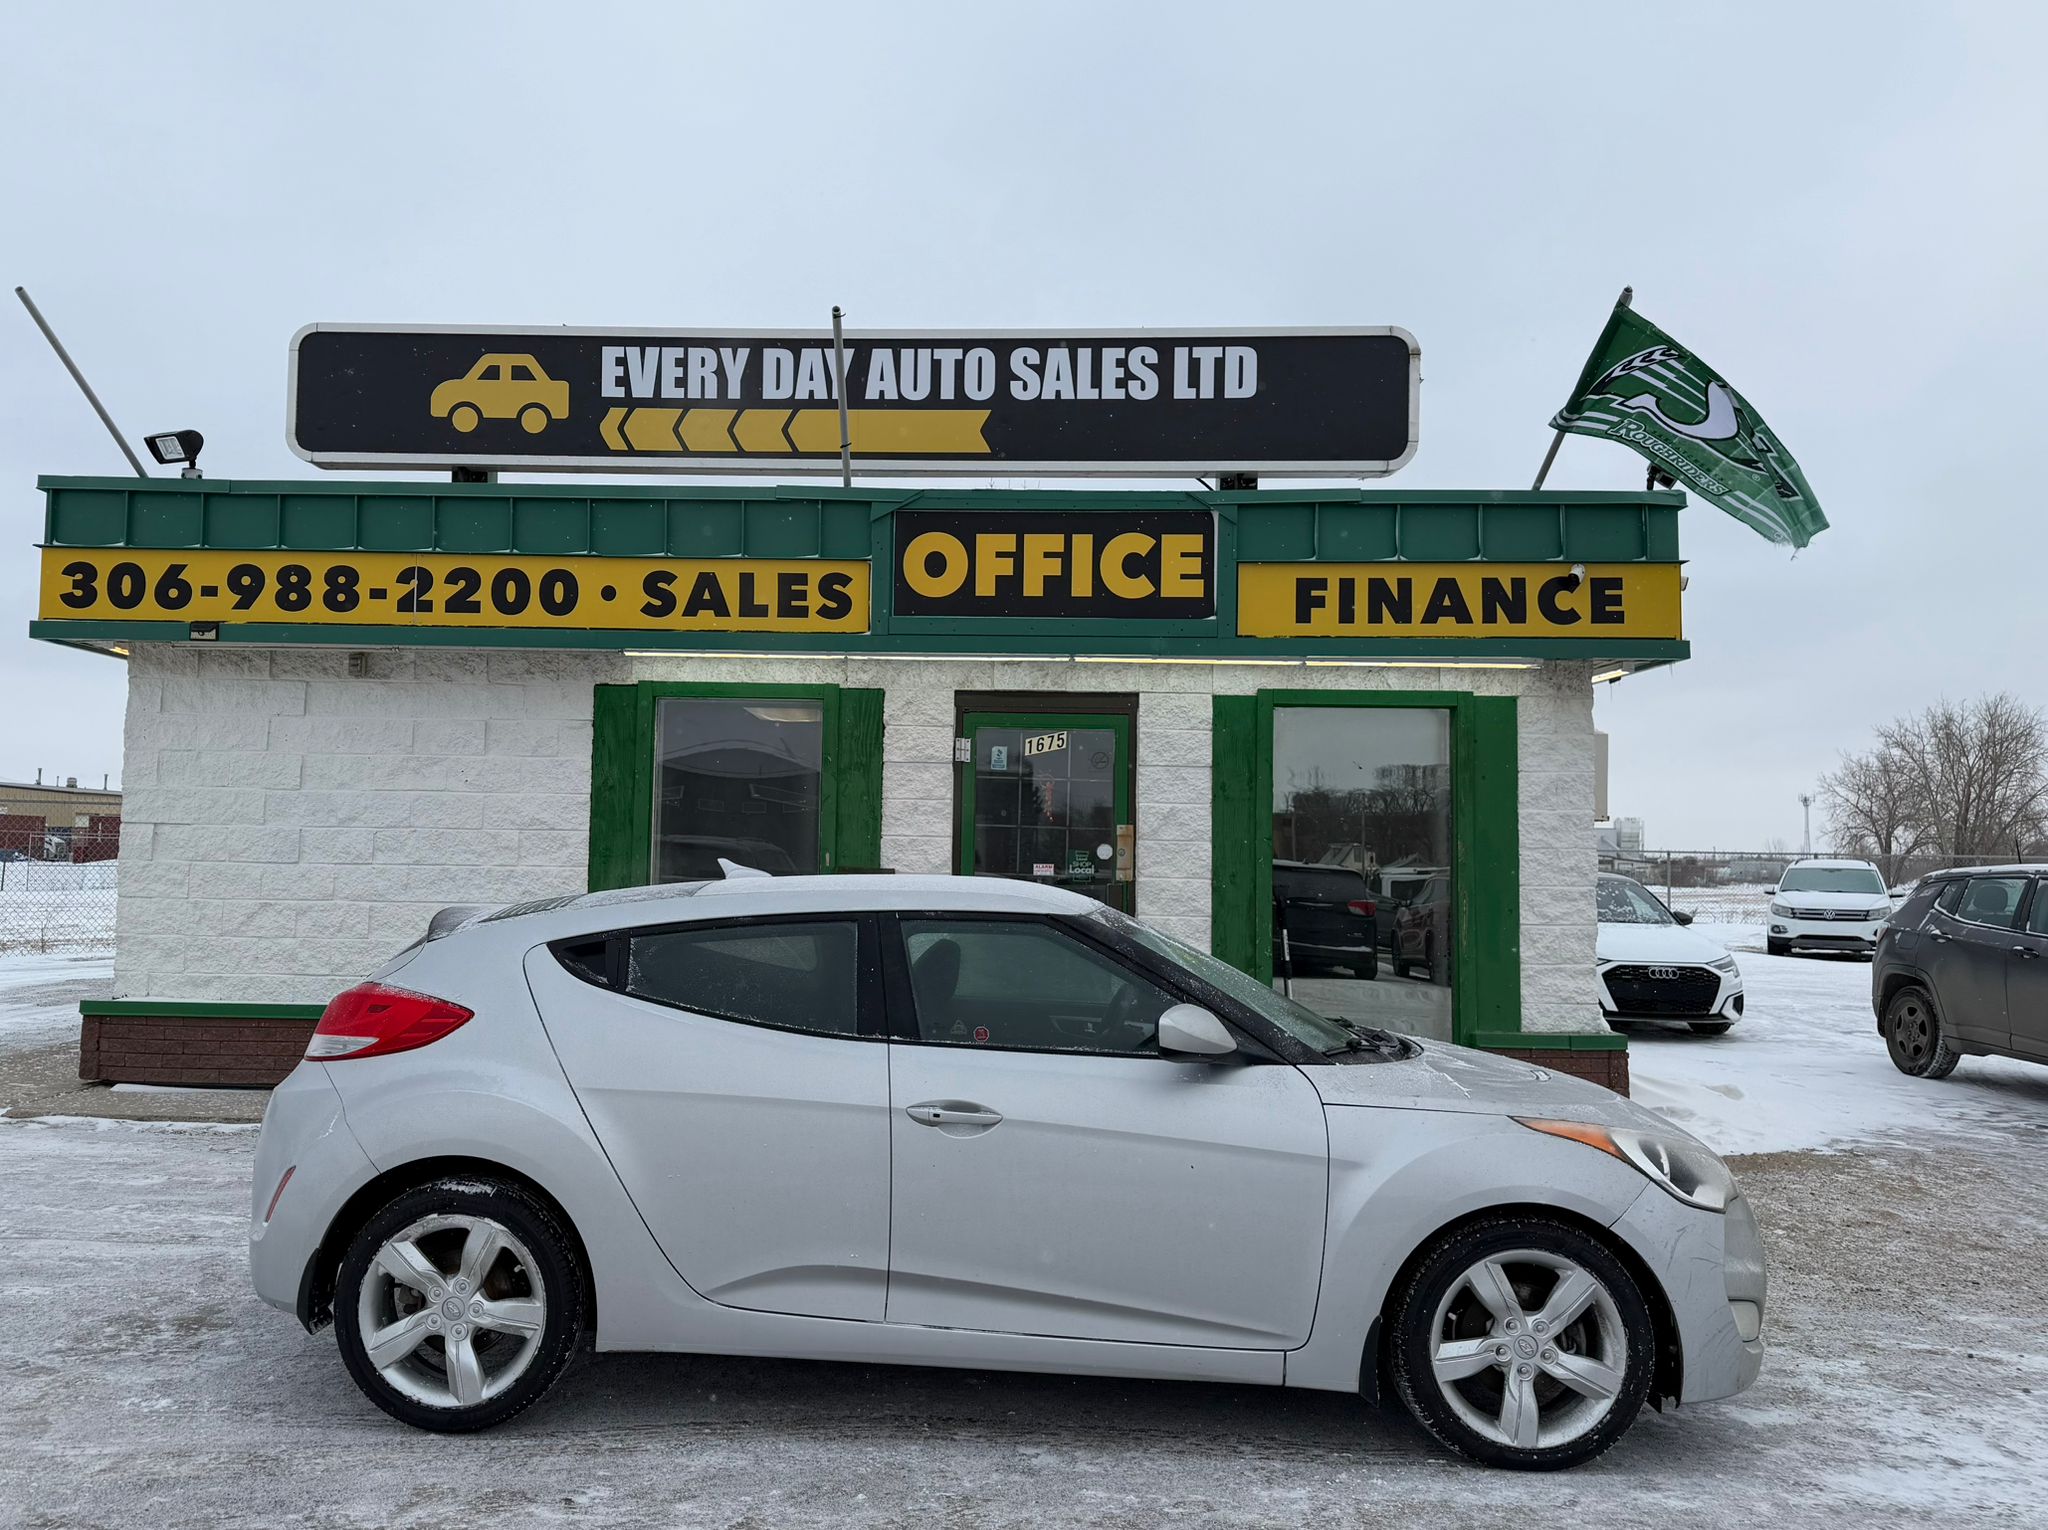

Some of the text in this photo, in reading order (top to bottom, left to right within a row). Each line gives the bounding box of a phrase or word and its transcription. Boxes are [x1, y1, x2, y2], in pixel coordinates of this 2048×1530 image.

[602, 346, 1258, 401] EVERY DAY AUTO SALES LTD
[1607, 418, 1729, 494] ROUGHRIDERS
[59, 561, 854, 620] 306-988-2200 SALES
[903, 531, 1204, 599] OFFICE
[1295, 576, 1625, 626] FINANCE
[1027, 732, 1065, 754] 1675
[1069, 864, 1095, 874] Local
